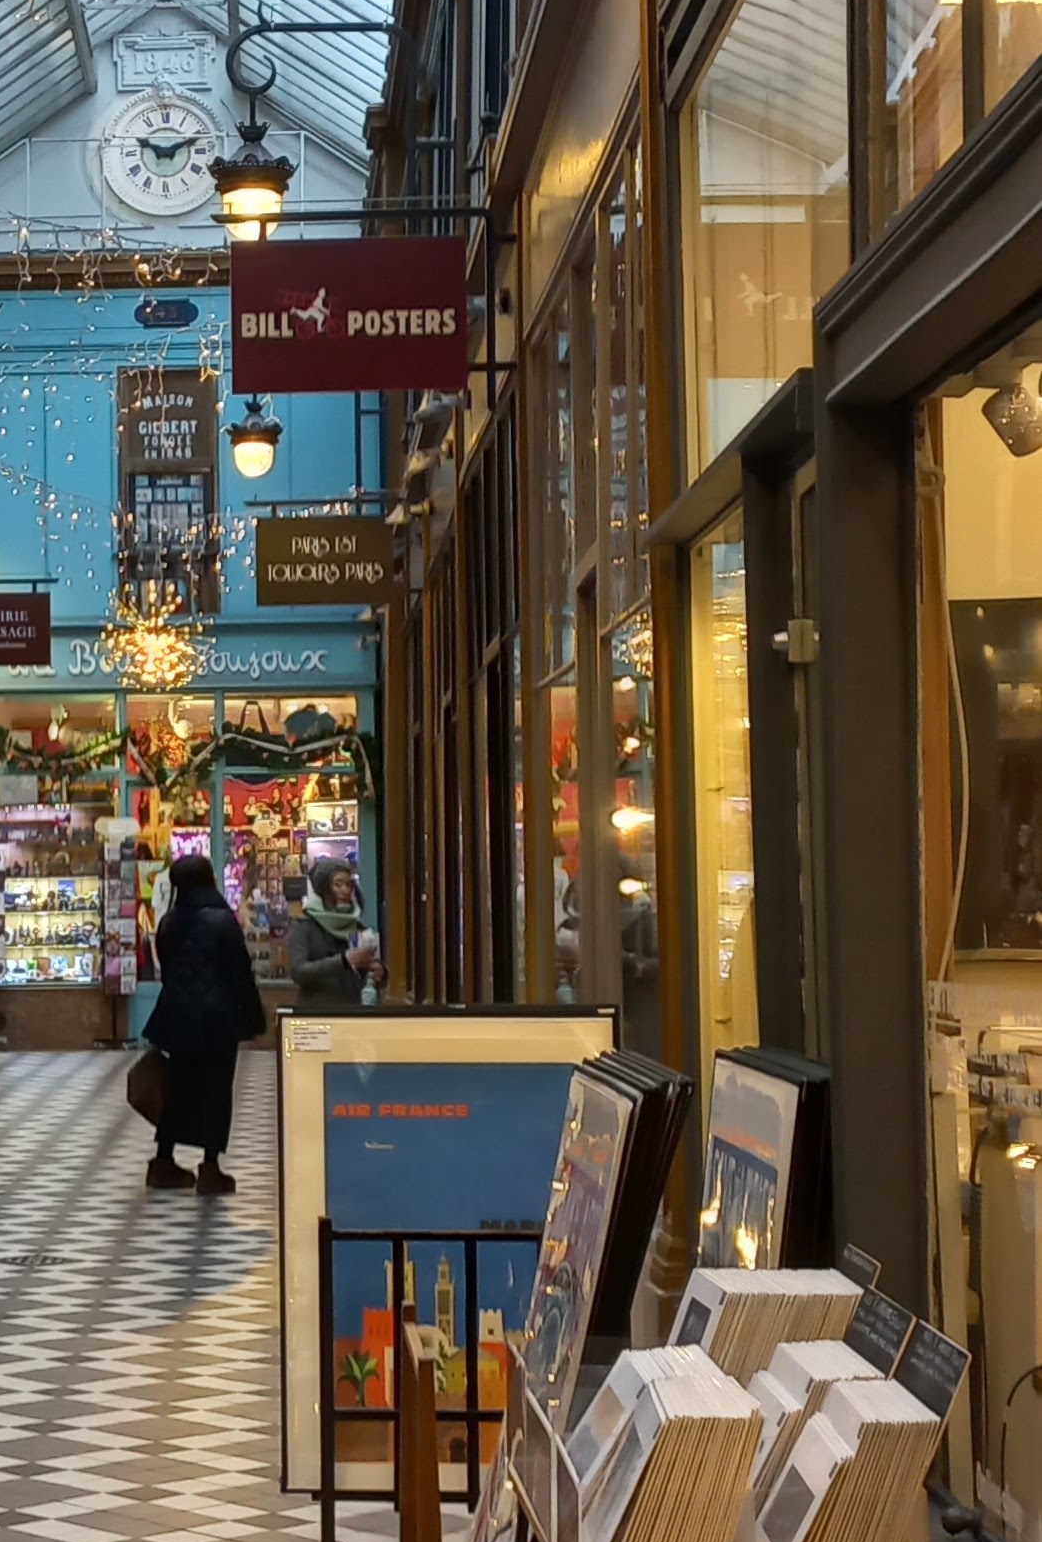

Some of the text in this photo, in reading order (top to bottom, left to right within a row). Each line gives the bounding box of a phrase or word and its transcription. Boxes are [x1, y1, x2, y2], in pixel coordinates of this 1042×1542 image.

[241, 307, 457, 339] BILL POSTERS
[142, 393, 194, 410] MAISON
[291, 534, 357, 558] PARIS EST
[345, 561, 384, 585] PARIS
[332, 1104, 470, 1119] AIR FRANCE
